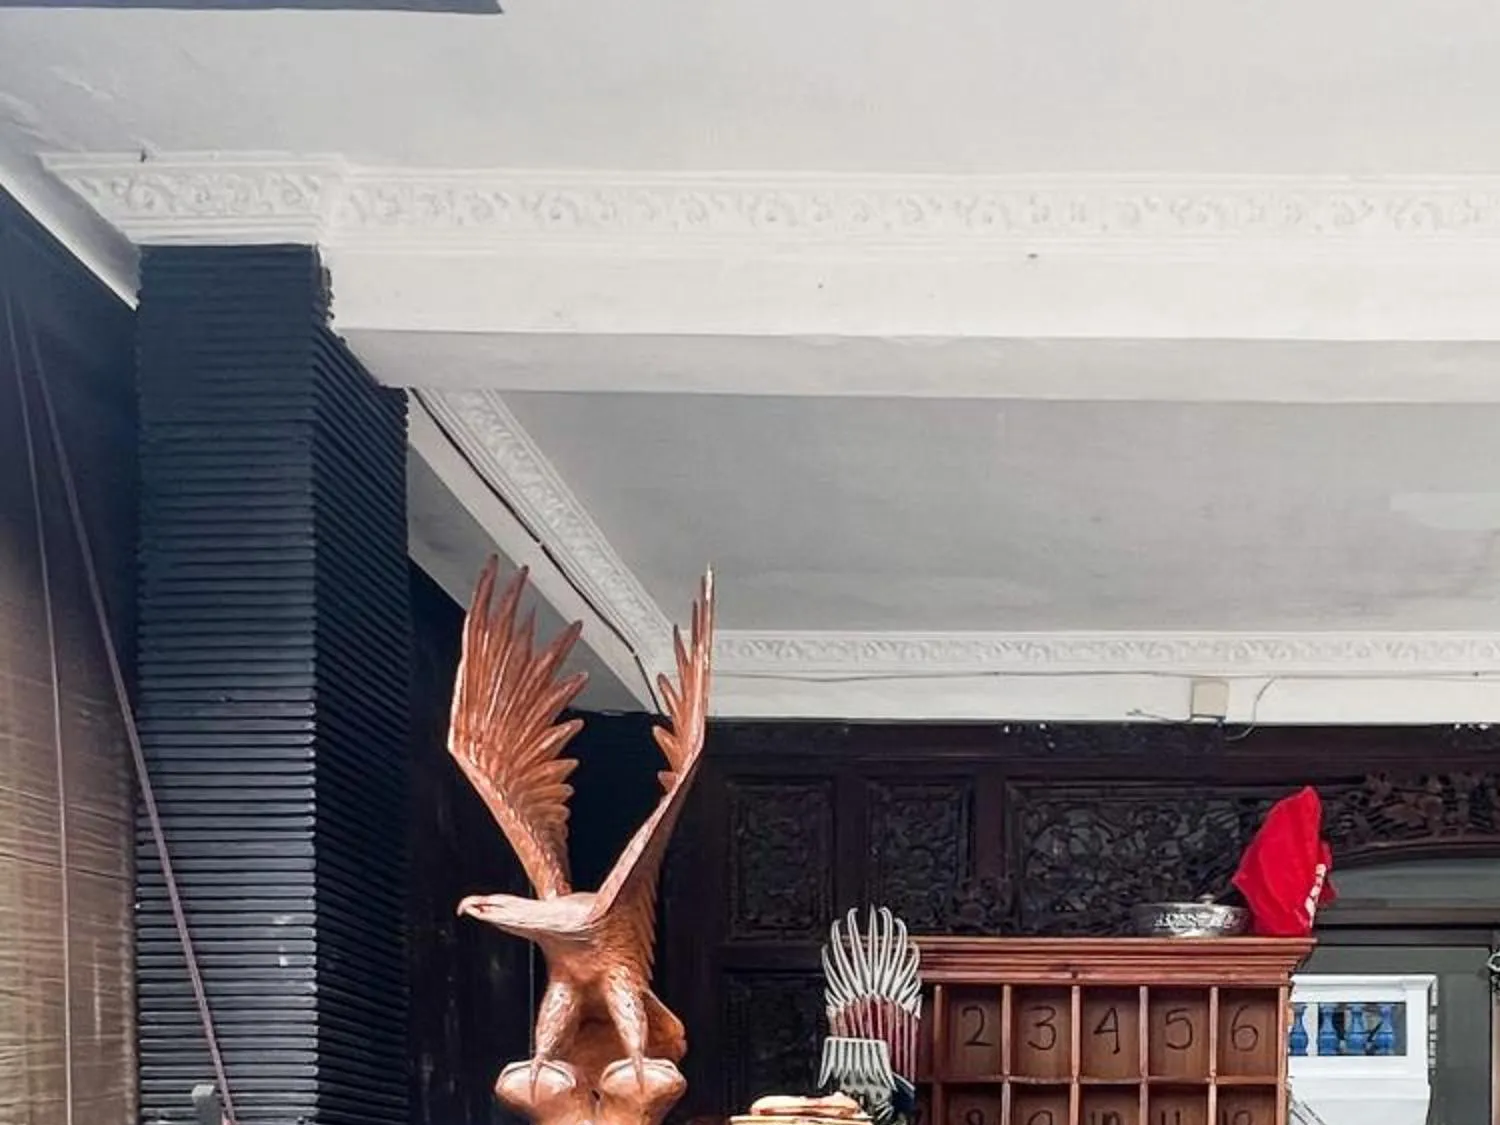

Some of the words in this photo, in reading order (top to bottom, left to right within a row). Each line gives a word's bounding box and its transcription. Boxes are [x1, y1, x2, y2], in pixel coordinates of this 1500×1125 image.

[962, 1006, 993, 1047] 2
[1027, 1006, 1058, 1051] 3
[1094, 1006, 1121, 1055] 4
[1165, 1007, 1193, 1052] 5
[1231, 1004, 1259, 1052] 6
